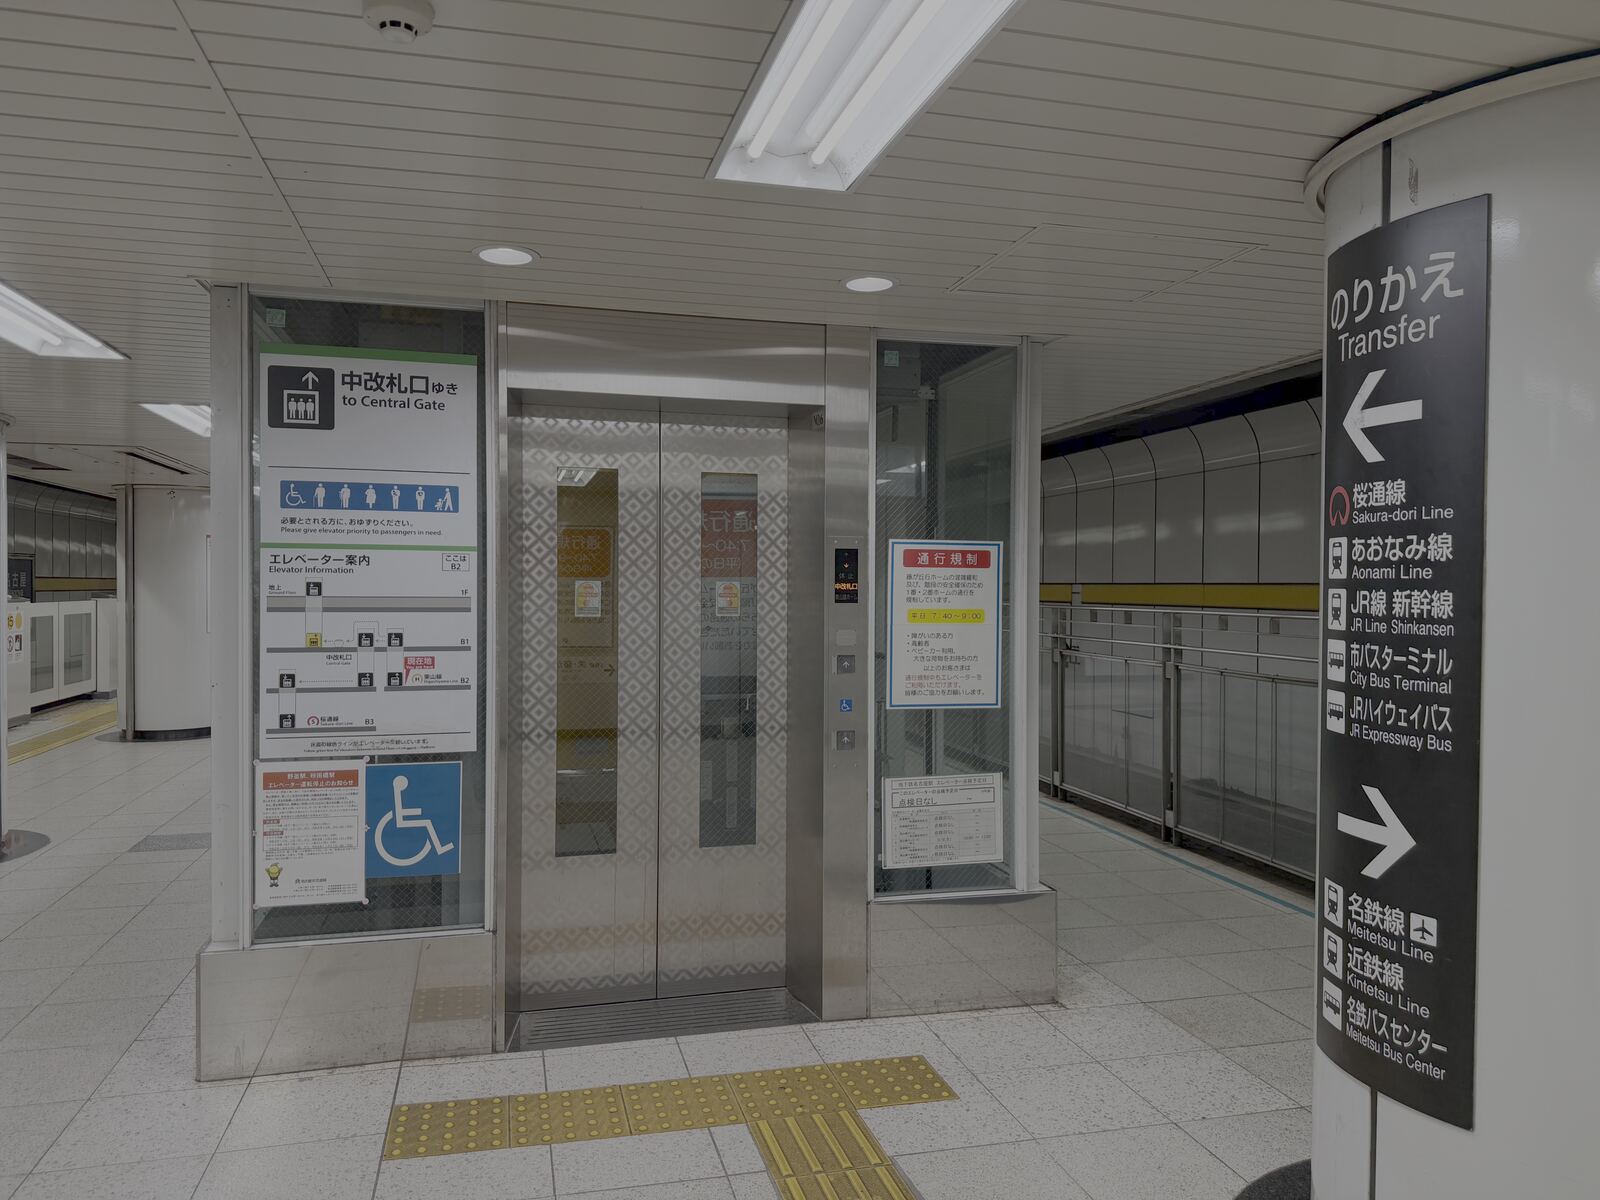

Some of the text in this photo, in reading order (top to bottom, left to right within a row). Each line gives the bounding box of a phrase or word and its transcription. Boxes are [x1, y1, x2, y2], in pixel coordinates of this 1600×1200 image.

[1330, 252, 1464, 330] のりかえ
[1338, 314, 1441, 362] Transfer
[341, 370, 458, 395] 中改札口ゆき
[342, 395, 446, 410] to Central Gate
[1352, 478, 1406, 508] 桜通線
[1352, 506, 1454, 524] Sakura-dori Line
[270, 554, 370, 566] エレベーター案内
[918, 552, 978, 565] 通行規制
[1351, 532, 1454, 562] あおなみ線
[269, 566, 354, 574] Elevator Information
[1352, 564, 1432, 580] Aonami Line
[1350, 589, 1454, 619] JR線 新幹線
[1350, 618, 1454, 636] JR Line Shinkansen
[1350, 642, 1453, 675] 市バスターミナル
[1350, 670, 1452, 694] City Bus Terminal
[1350, 696, 1452, 732] JRハイウェイバス
[1350, 722, 1452, 752] JR Expressway Bus
[1348, 892, 1405, 937] 名鉄線
[1348, 919, 1434, 963] Meitetsu Line
[1348, 944, 1404, 992] 近鉄線
[1347, 970, 1430, 1018] Kintetsu Line
[1346, 996, 1448, 1054] 名鉄バスセンター
[1346, 1022, 1446, 1081] Meitetsu Bus Center
